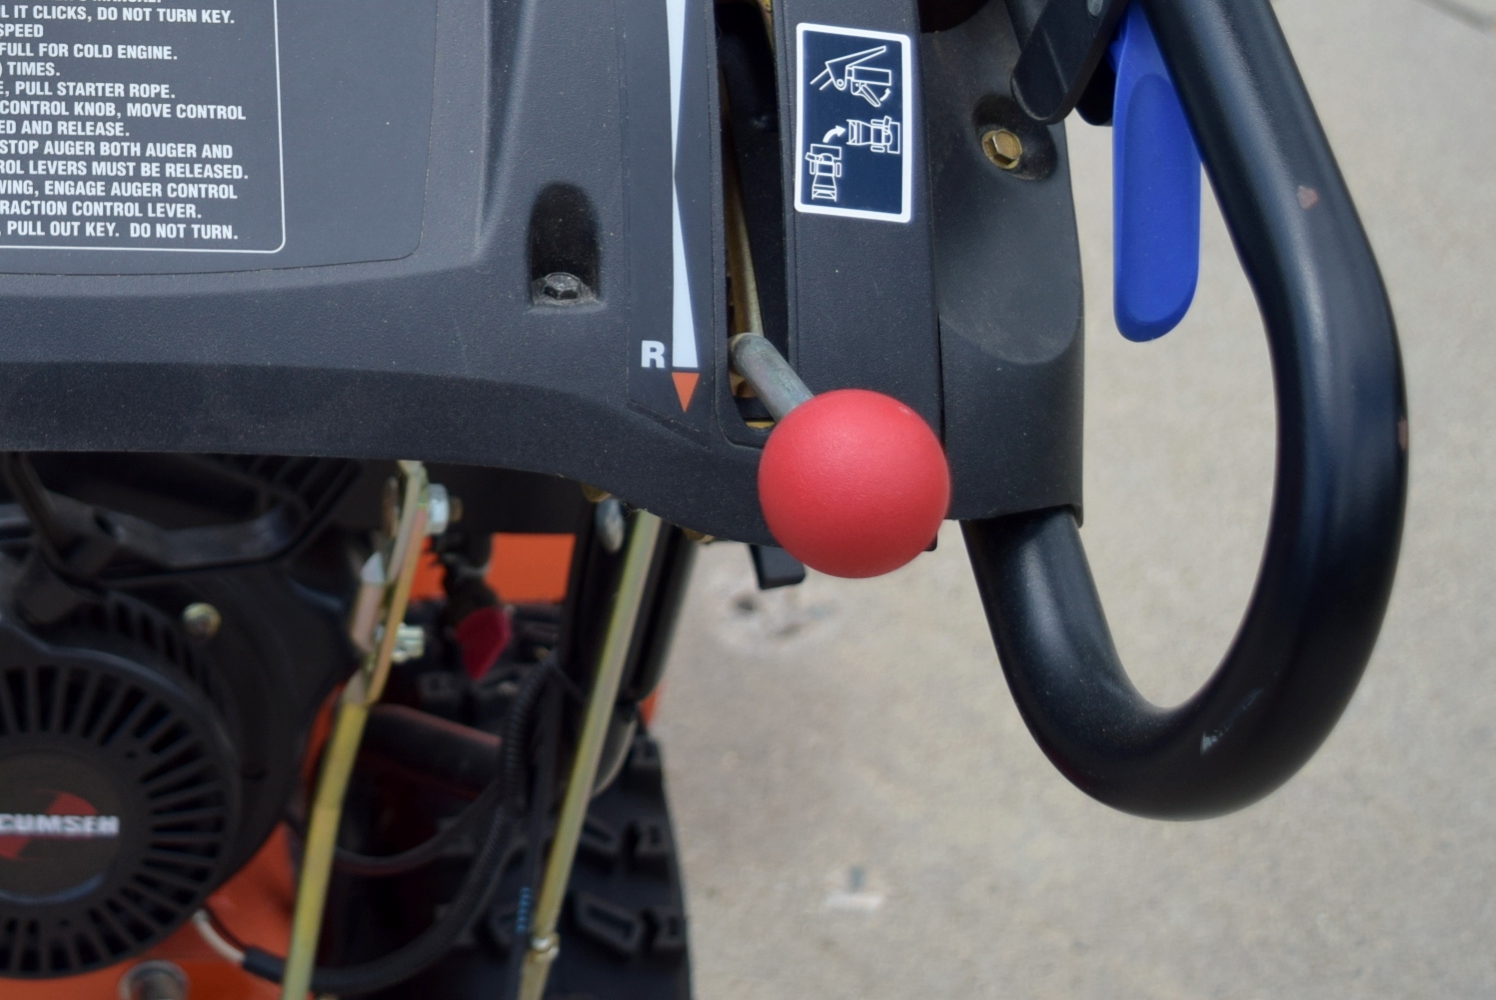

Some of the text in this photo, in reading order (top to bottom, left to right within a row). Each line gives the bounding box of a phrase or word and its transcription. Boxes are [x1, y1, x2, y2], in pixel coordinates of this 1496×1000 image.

[14, 5, 28, 18] IT
[33, 6, 91, 22] CLICKS,
[98, 7, 117, 20] DO
[123, 8, 152, 21] NOT
[157, 9, 196, 22] TURN
[202, 10, 234, 23] KEY.
[39, 43, 68, 57] FOR
[74, 44, 112, 58] COLD
[118, 45, 177, 59] ENGINE.
[7, 62, 60, 76] TIMES.
[16, 81, 52, 95] PULL
[57, 82, 124, 97] STARTER
[130, 84, 175, 98] ROPE.
[0, 100, 69, 115] CONTROL
[74, 102, 121, 118] KNOB,
[127, 103, 171, 117] MOVE
[177, 104, 246, 119] CONTROL
[21, 121, 52, 134] AND
[58, 121, 129, 136] RELEASE.
[0, 140, 38, 154] STOP
[44, 141, 95, 155] AUGER
[100, 142, 140, 156] BOTH
[146, 143, 196, 157] AUGER
[202, 144, 232, 158] AND
[29, 160, 87, 175] LEVERS
[92, 162, 136, 176] MUST
[141, 163, 160, 176] BE
[166, 163, 248, 179] RELEASED.
[45, 181, 105, 195] ENGAGE
[111, 182, 162, 196] AUGER
[167, 183, 237, 198] CONTROL
[72, 201, 142, 217] CONTROL
[148, 203, 201, 218] LEVER.
[8, 221, 45, 235] PULL
[50, 221, 80, 236] OUT
[86, 222, 119, 236] KEY.
[130, 223, 150, 237] DO
[156, 224, 186, 238] NOT
[191, 225, 237, 239] TURN.
[642, 341, 665, 368] R
